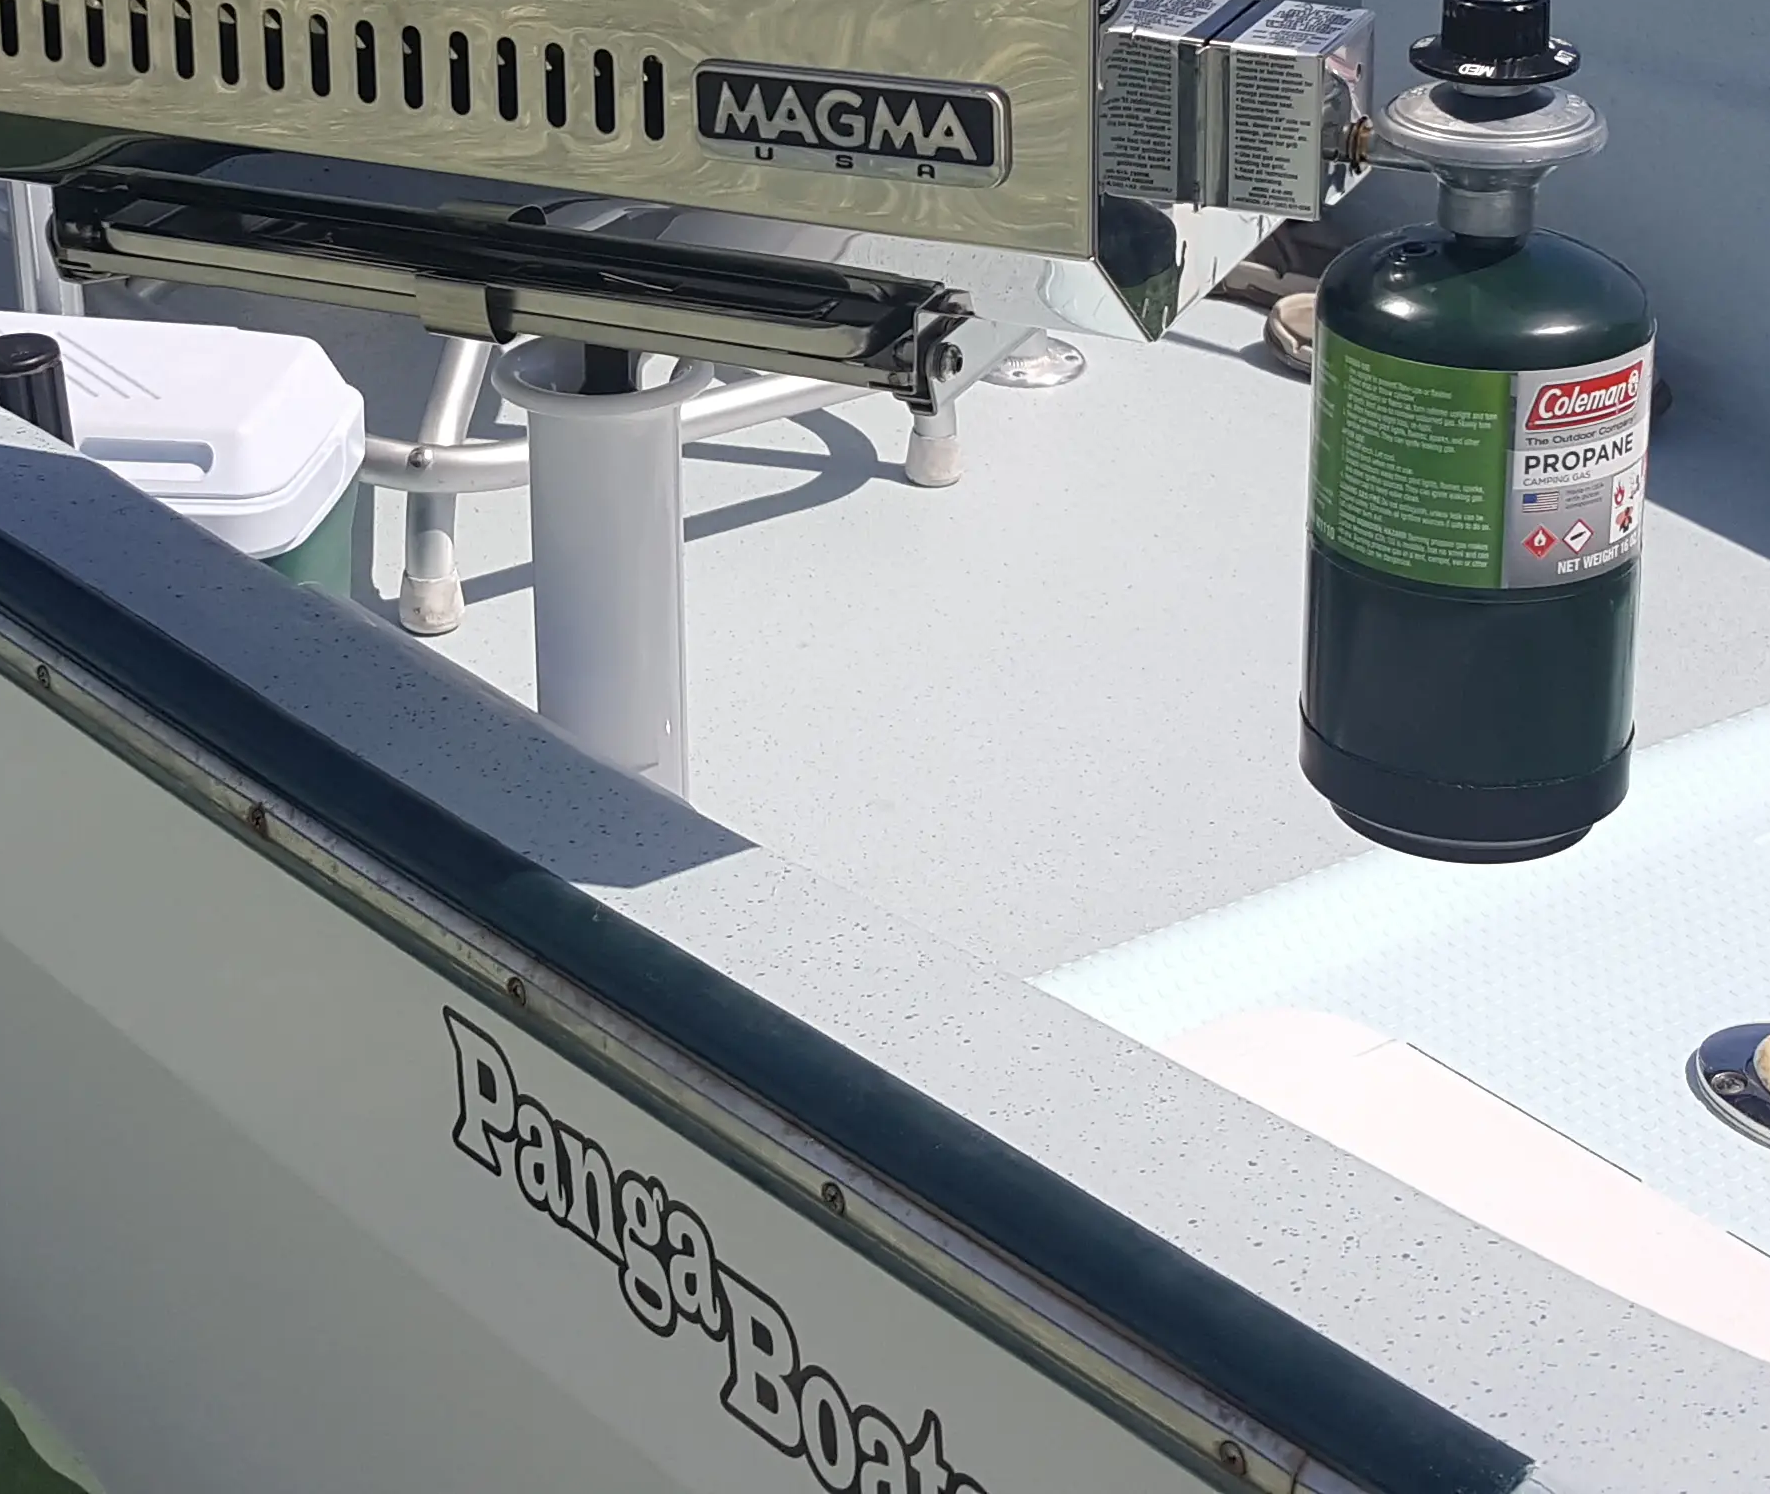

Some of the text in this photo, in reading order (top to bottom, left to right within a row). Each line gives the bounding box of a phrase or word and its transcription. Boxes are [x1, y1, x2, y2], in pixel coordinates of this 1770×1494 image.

[713, 80, 979, 162] MAGMA
[1537, 380, 1627, 420] Coleman
[1523, 430, 1634, 476] PROPANE
[1525, 437, 1550, 447] The
[1552, 430, 1597, 444] Outdoor
[1522, 470, 1592, 487] CAMPING GAS
[1557, 557, 1581, 575] NET
[1582, 545, 1619, 570] WEIGHT
